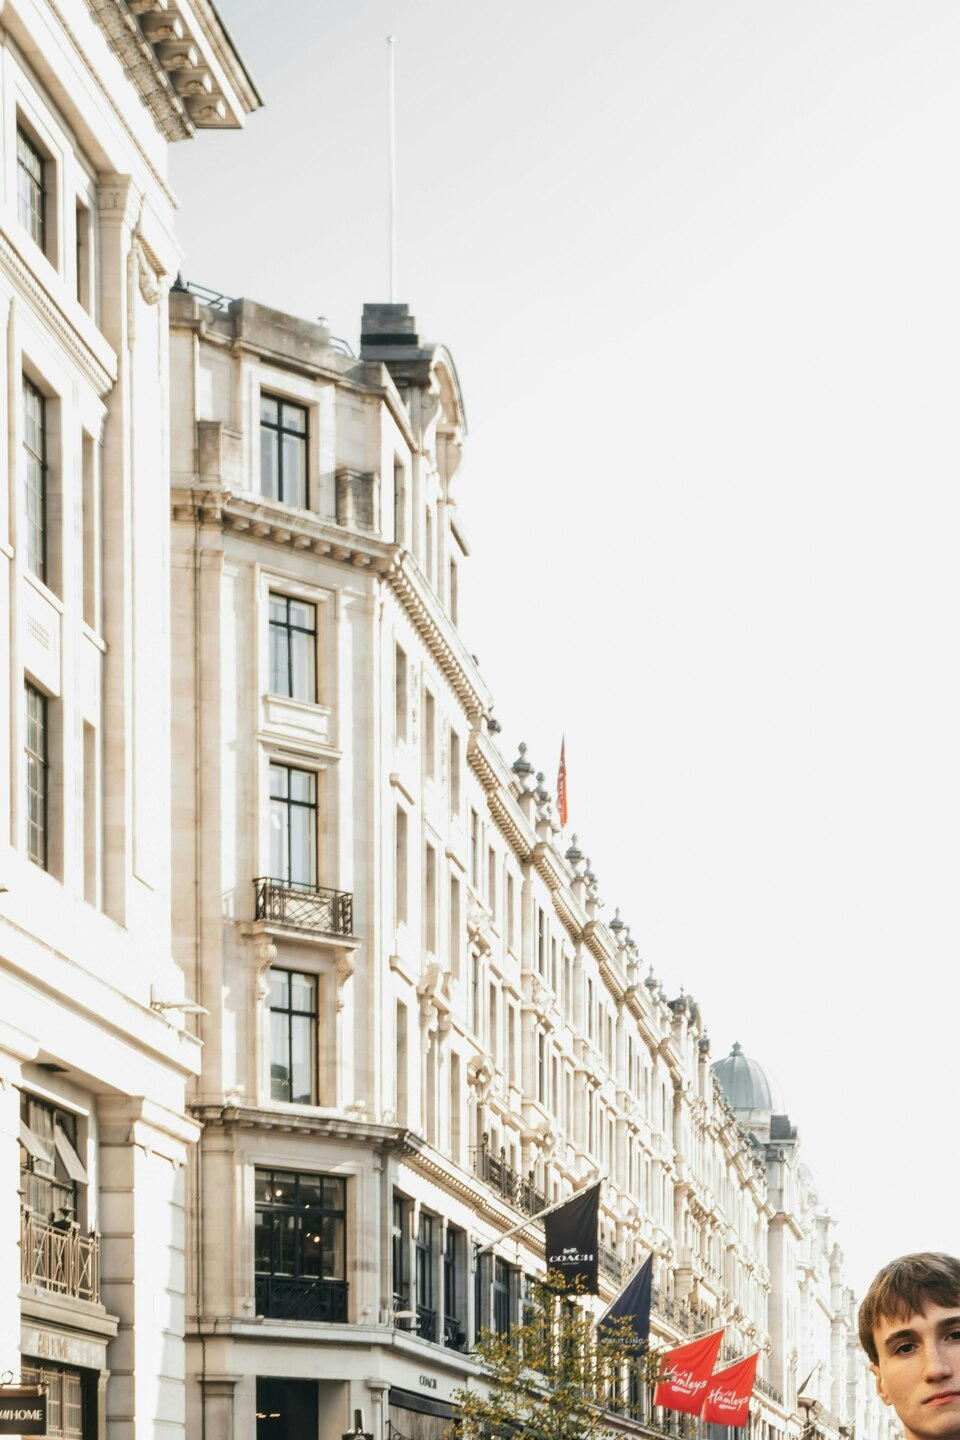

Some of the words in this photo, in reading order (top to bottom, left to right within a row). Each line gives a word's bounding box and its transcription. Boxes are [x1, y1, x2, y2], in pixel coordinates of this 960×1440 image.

[549, 1253, 594, 1262] COACH
[419, 1375, 437, 1389] COACH
[707, 1386, 749, 1411] Hamleys
[10, 1409, 43, 1420] HOME
